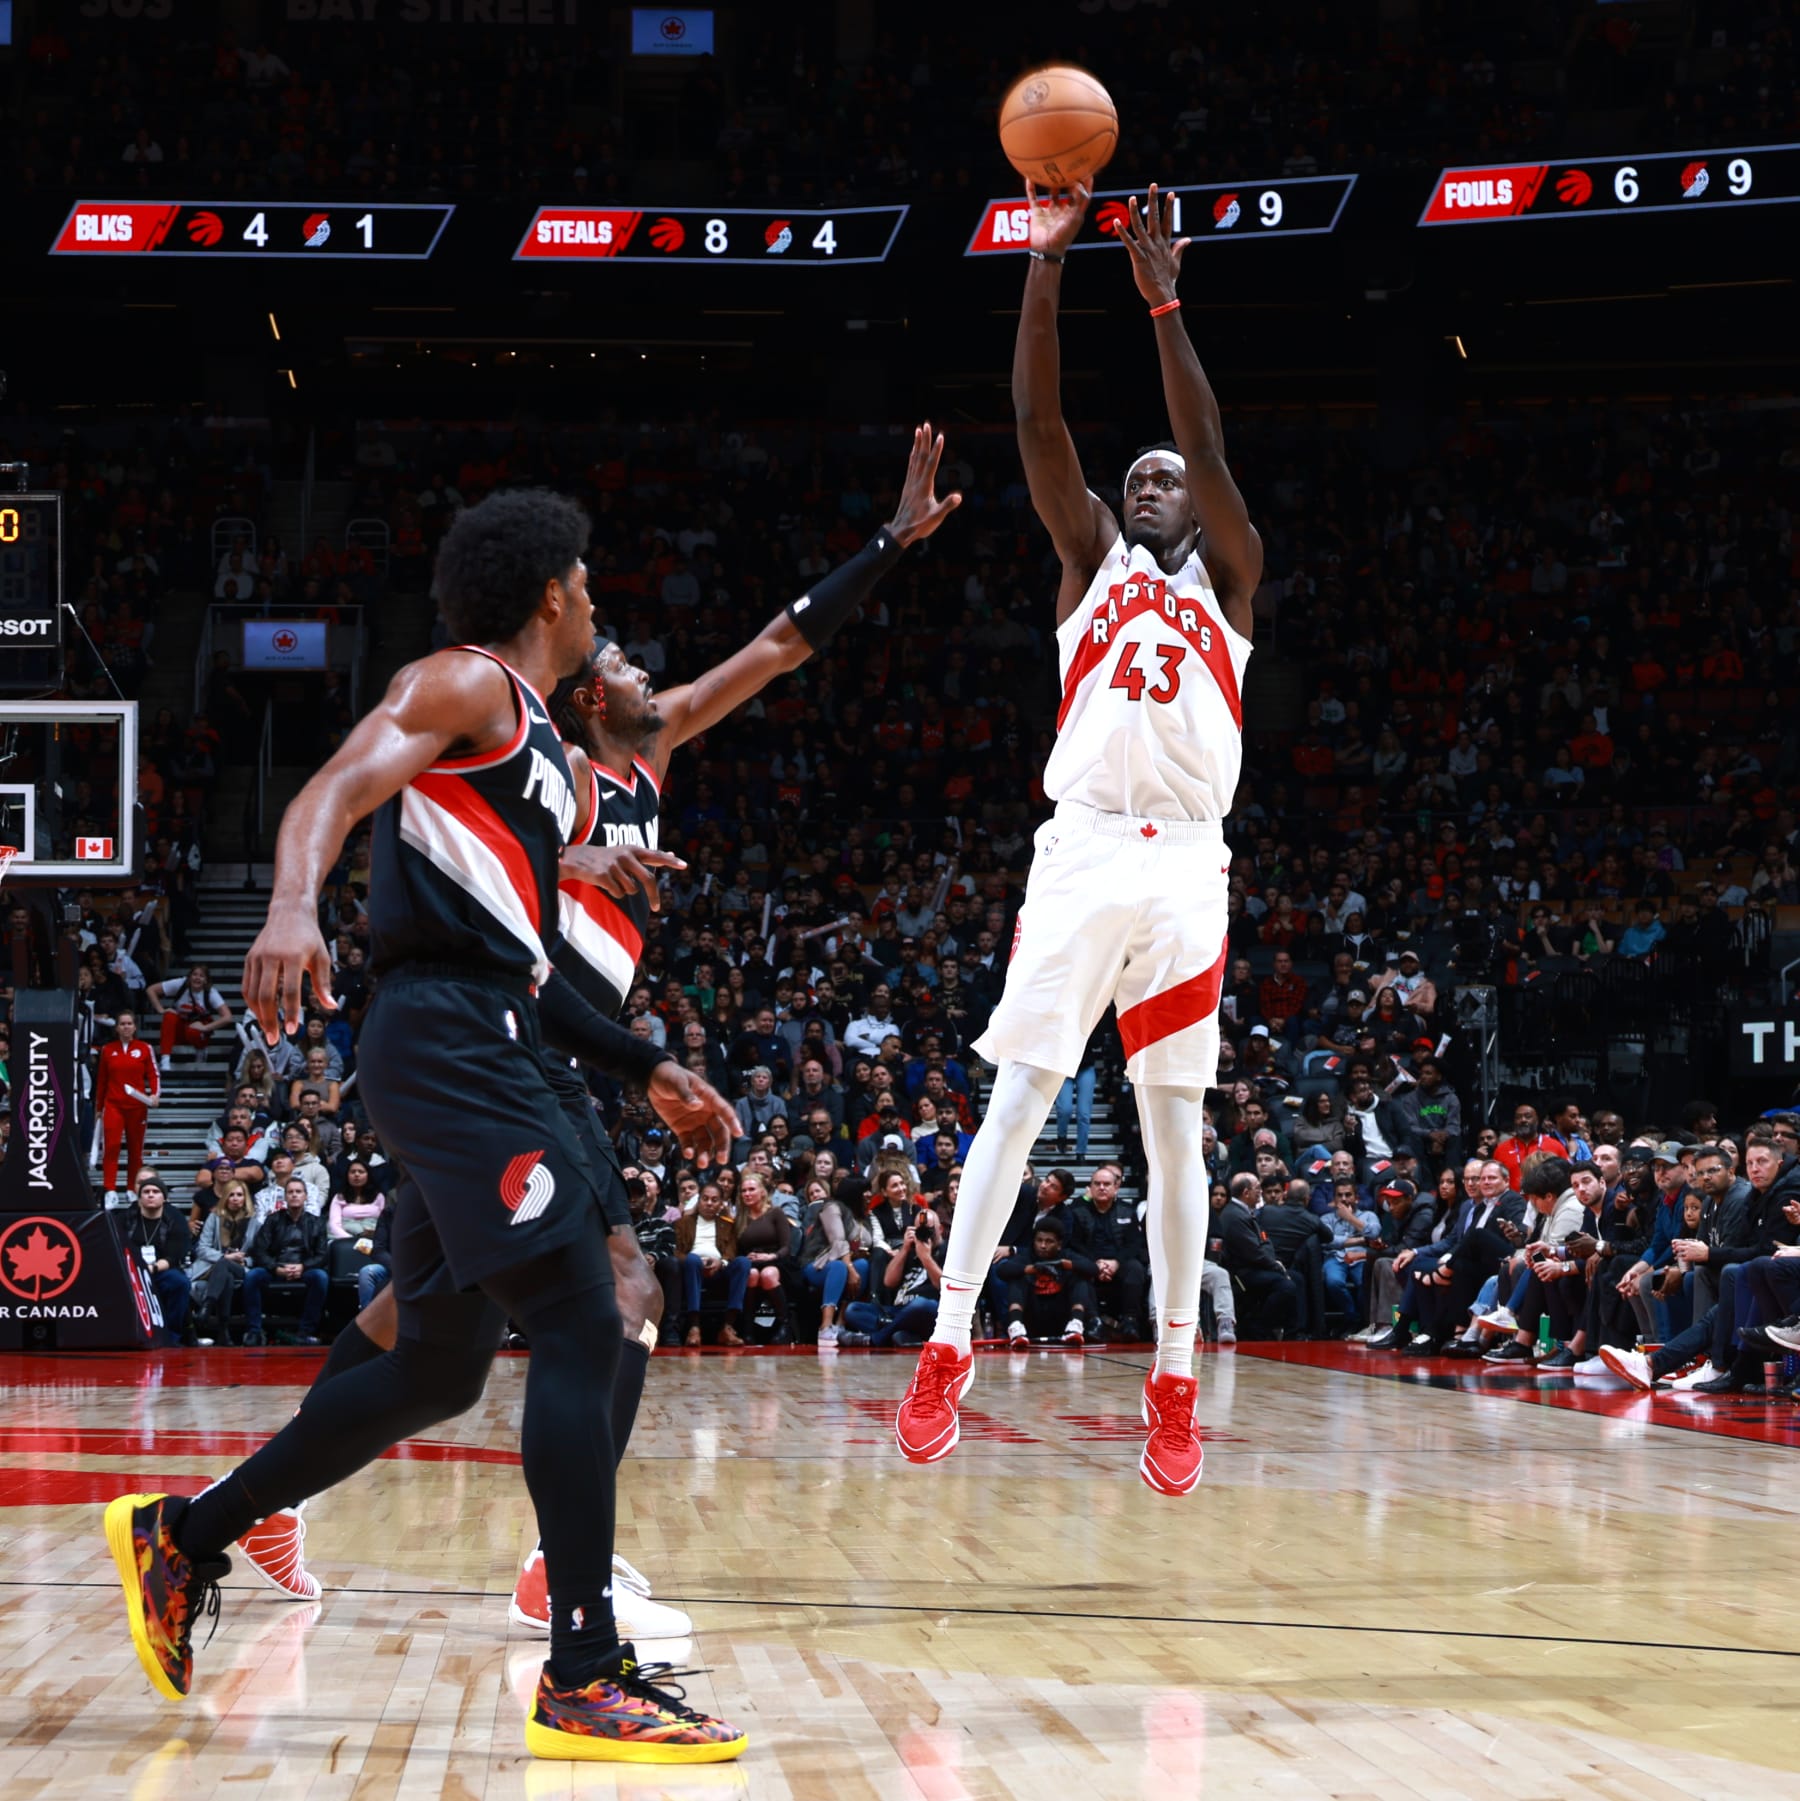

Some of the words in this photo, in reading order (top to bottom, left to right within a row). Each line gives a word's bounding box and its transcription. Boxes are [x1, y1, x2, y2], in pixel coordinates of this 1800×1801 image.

[399, 0, 579, 25] STREET
[1444, 179, 1513, 208] FOULS
[1614, 166, 1640, 203] 6
[1727, 159, 1753, 195] 9
[1258, 190, 1284, 227] 9
[75, 214, 133, 242] BLKS
[242, 212, 269, 247] 4
[355, 213, 374, 248] 1
[537, 220, 613, 244] STEALS
[704, 219, 729, 253] 8
[811, 220, 838, 254] 4
[0, 619, 53, 635] SOT
[1092, 582, 1212, 653] RAPTORS
[1109, 642, 1187, 705] 43
[28, 1031, 53, 1190] JACKPOTCITY
[15, 1305, 98, 1319] CANADA
